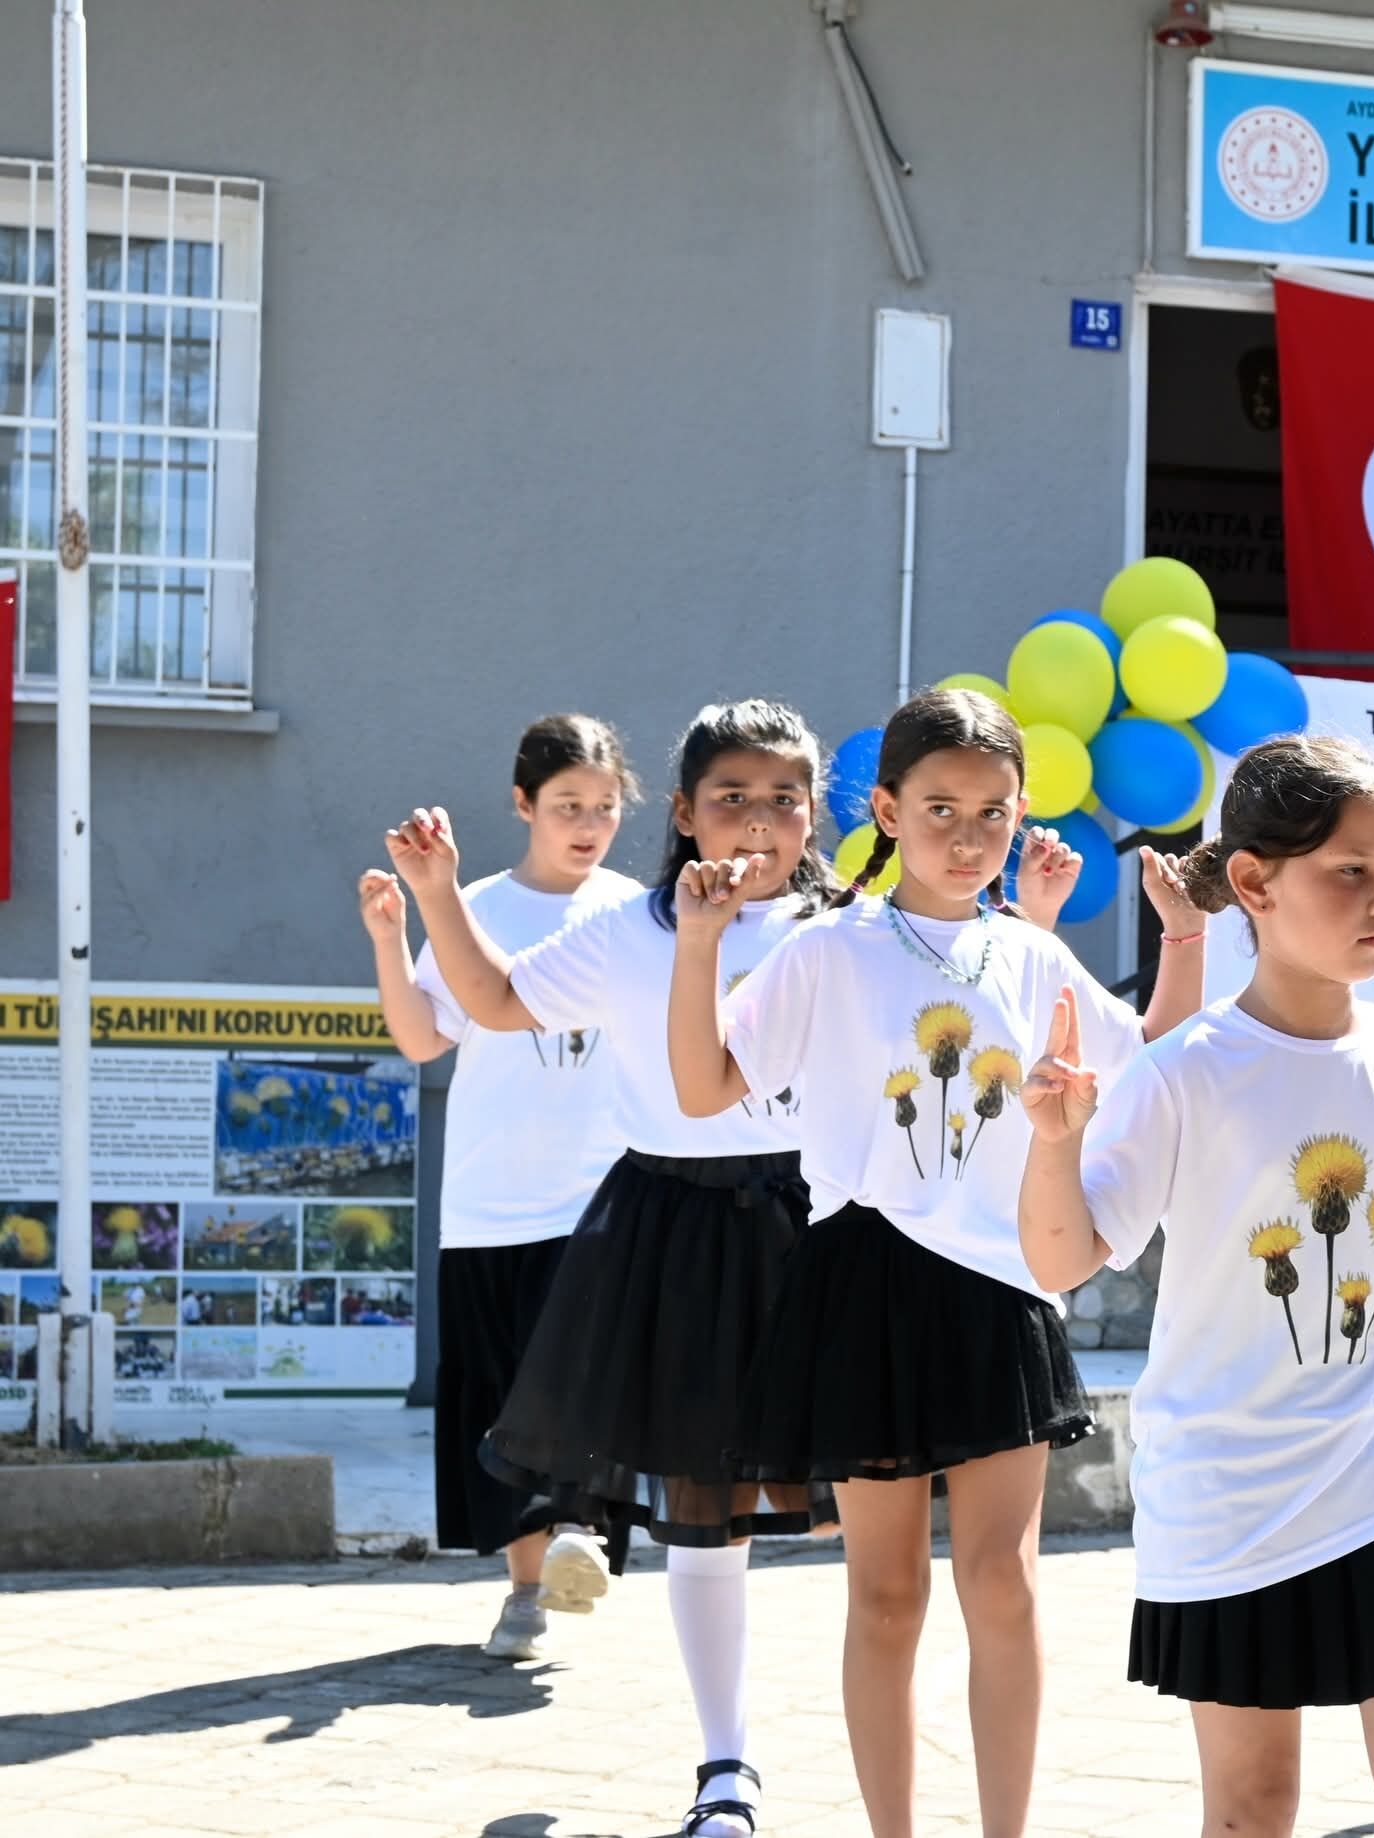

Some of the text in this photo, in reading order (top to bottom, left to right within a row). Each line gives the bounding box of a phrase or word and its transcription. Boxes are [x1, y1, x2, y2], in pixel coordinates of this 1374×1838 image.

[1086, 307, 1110, 331] 15
[14, 996, 206, 1038] TÜŞAHI'NI
[214, 1006, 391, 1038] KORUYORUZ
